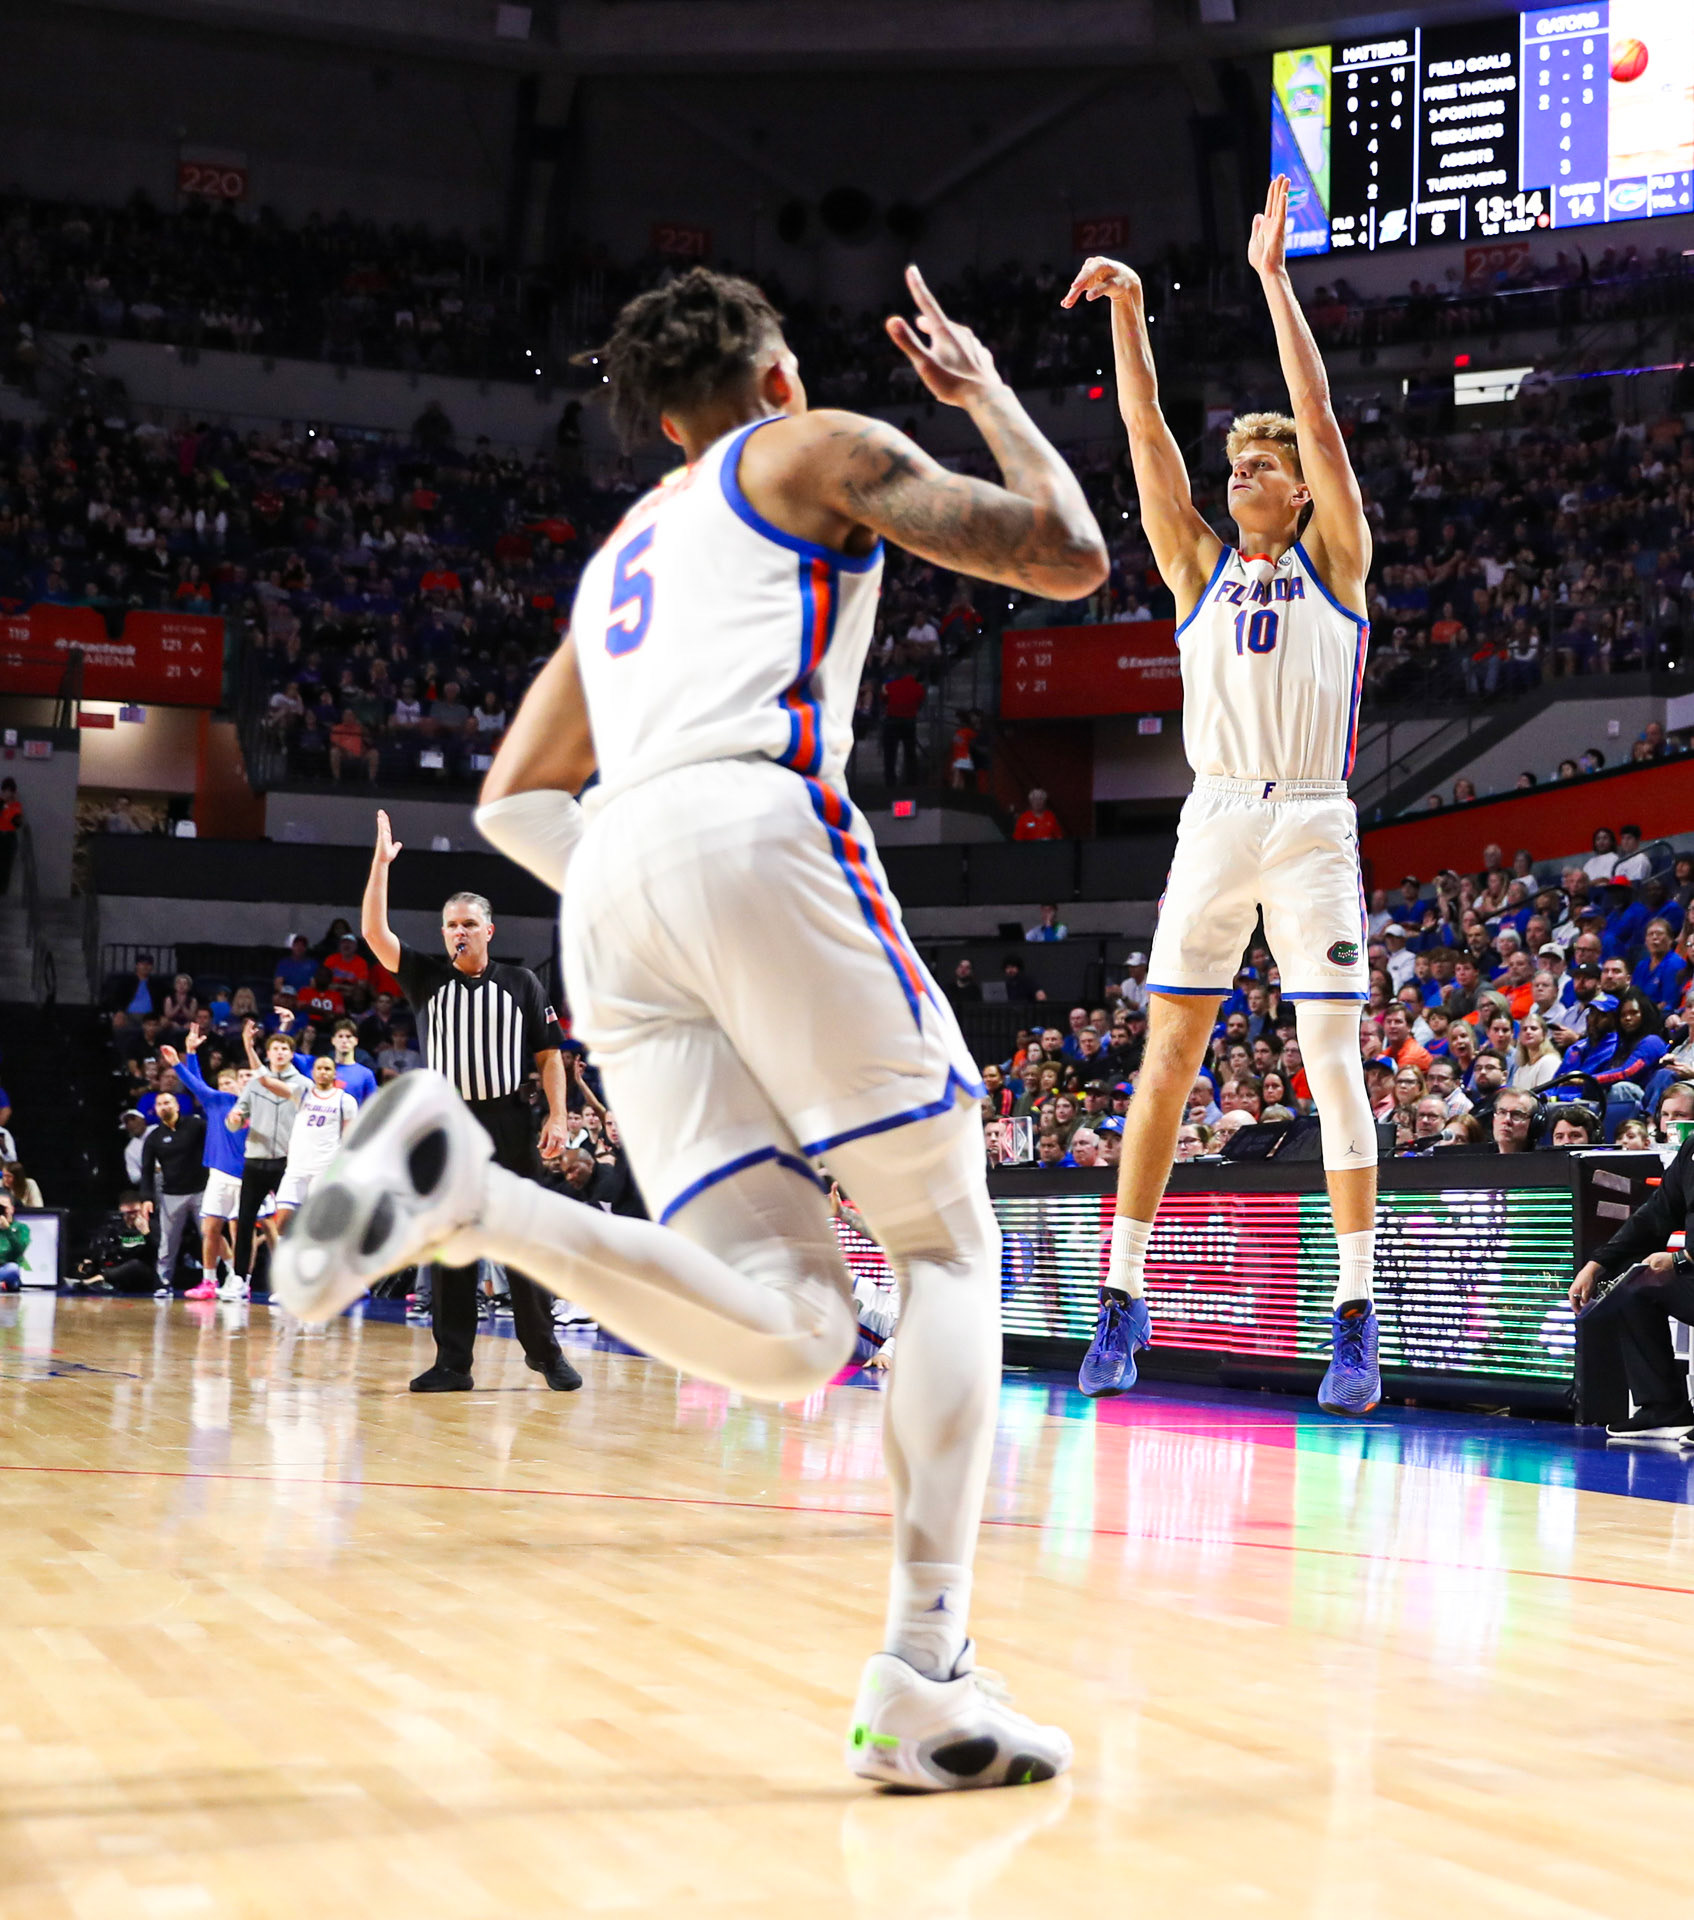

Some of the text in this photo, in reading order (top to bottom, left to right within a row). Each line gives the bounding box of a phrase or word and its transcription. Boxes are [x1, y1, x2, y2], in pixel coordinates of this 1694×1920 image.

[1536, 11, 1600, 36] GATORS
[1342, 39, 1408, 64] HATTERS
[1428, 52, 1511, 78] FIELD GOALS
[1423, 75, 1516, 102] FREE THROWS
[1428, 99, 1505, 124] 3-POINTERS
[1349, 120, 1358, 136] 1
[1390, 114, 1402, 130] 4
[1431, 122, 1504, 146] REBOUNDS
[1367, 138, 1379, 154] 4
[1560, 135, 1572, 151] 4
[1369, 161, 1378, 177] 1
[1559, 159, 1572, 175] 3
[1680, 172, 1690, 186] 1
[182, 166, 243, 197] 220
[1426, 169, 1507, 193] TURNOVERS
[1474, 191, 1544, 224] 13:14
[1567, 194, 1596, 219] 14
[1678, 191, 1690, 206] 4
[659, 228, 705, 257] 221
[1082, 221, 1124, 249] 221
[1358, 231, 1368, 244] 4
[605, 520, 658, 659] 5
[1234, 609, 1280, 656] 10
[83, 653, 136, 667] ARENA
[166, 664, 182, 678] 21
[1262, 781, 1277, 800] F
[307, 1114, 327, 1128] 20
